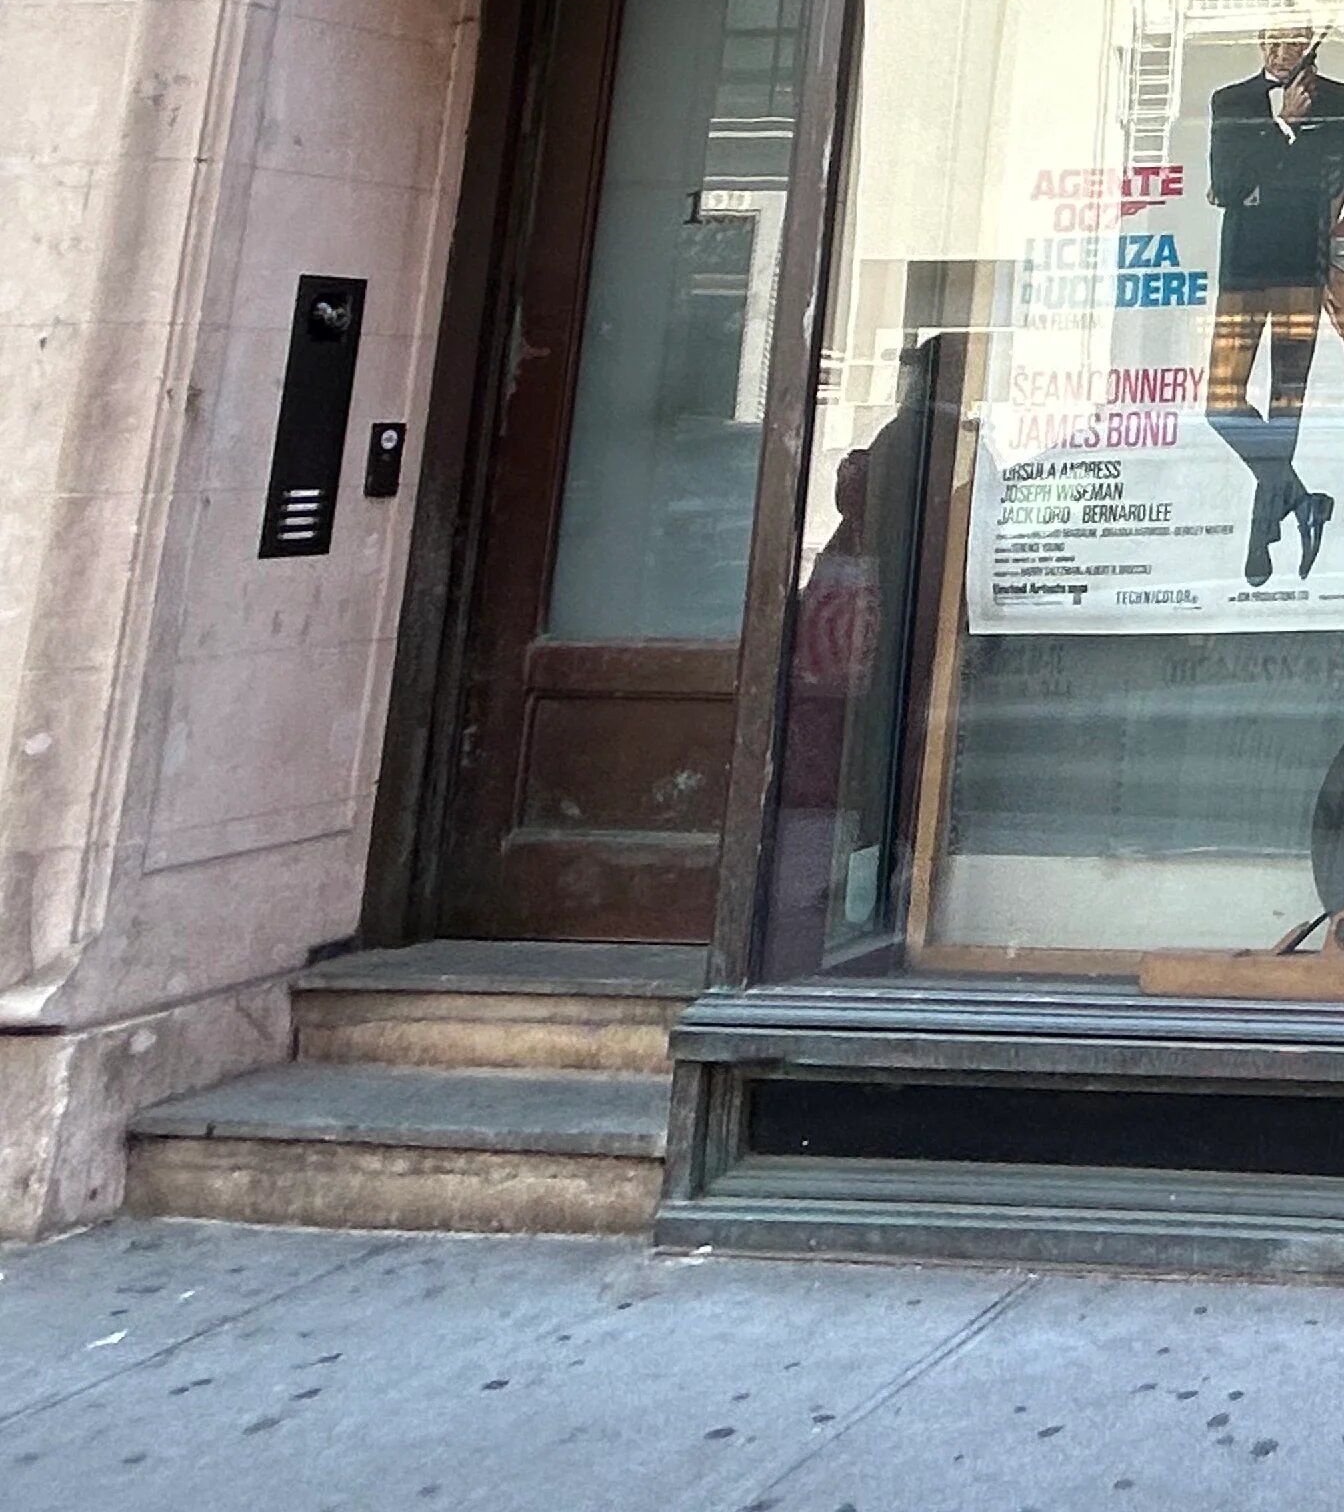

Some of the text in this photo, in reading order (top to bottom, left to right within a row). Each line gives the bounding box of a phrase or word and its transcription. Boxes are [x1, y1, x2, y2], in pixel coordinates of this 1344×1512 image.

[1030, 165, 1184, 201] AGENTE
[1044, 271, 1208, 310] UCCDERE
[1008, 410, 1179, 450] JAMES BOND
[1000, 483, 1124, 504] JOSEPH WISEMAN
[1082, 503, 1146, 524] BERNARD
[1148, 502, 1174, 522] LEE
